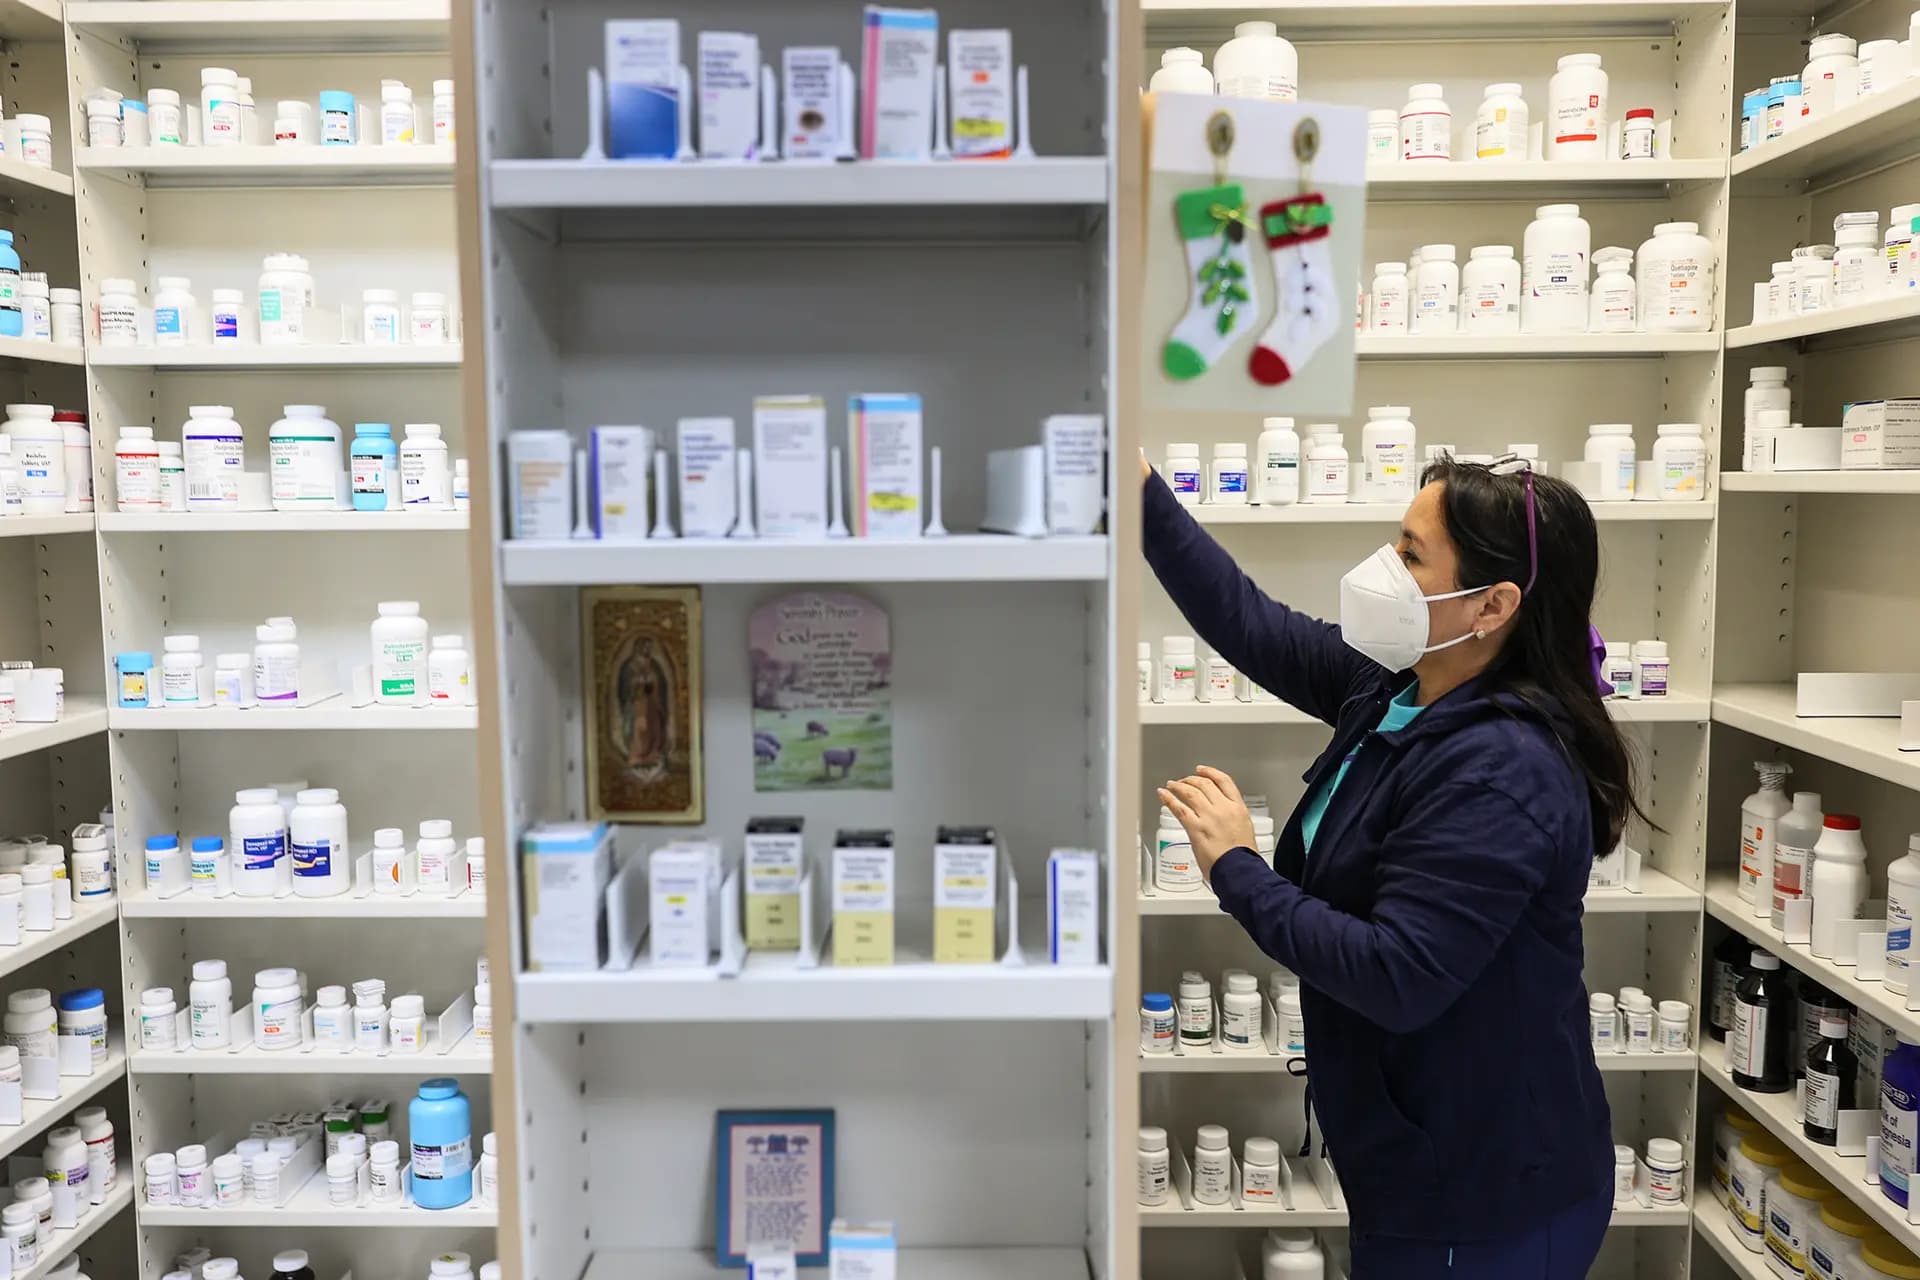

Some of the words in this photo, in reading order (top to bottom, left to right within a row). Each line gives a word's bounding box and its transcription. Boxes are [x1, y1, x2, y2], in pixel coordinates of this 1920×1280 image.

[776, 627, 811, 645] God
[1889, 1115, 1899, 1128] of
[1882, 1124, 1911, 1149] agnesia
